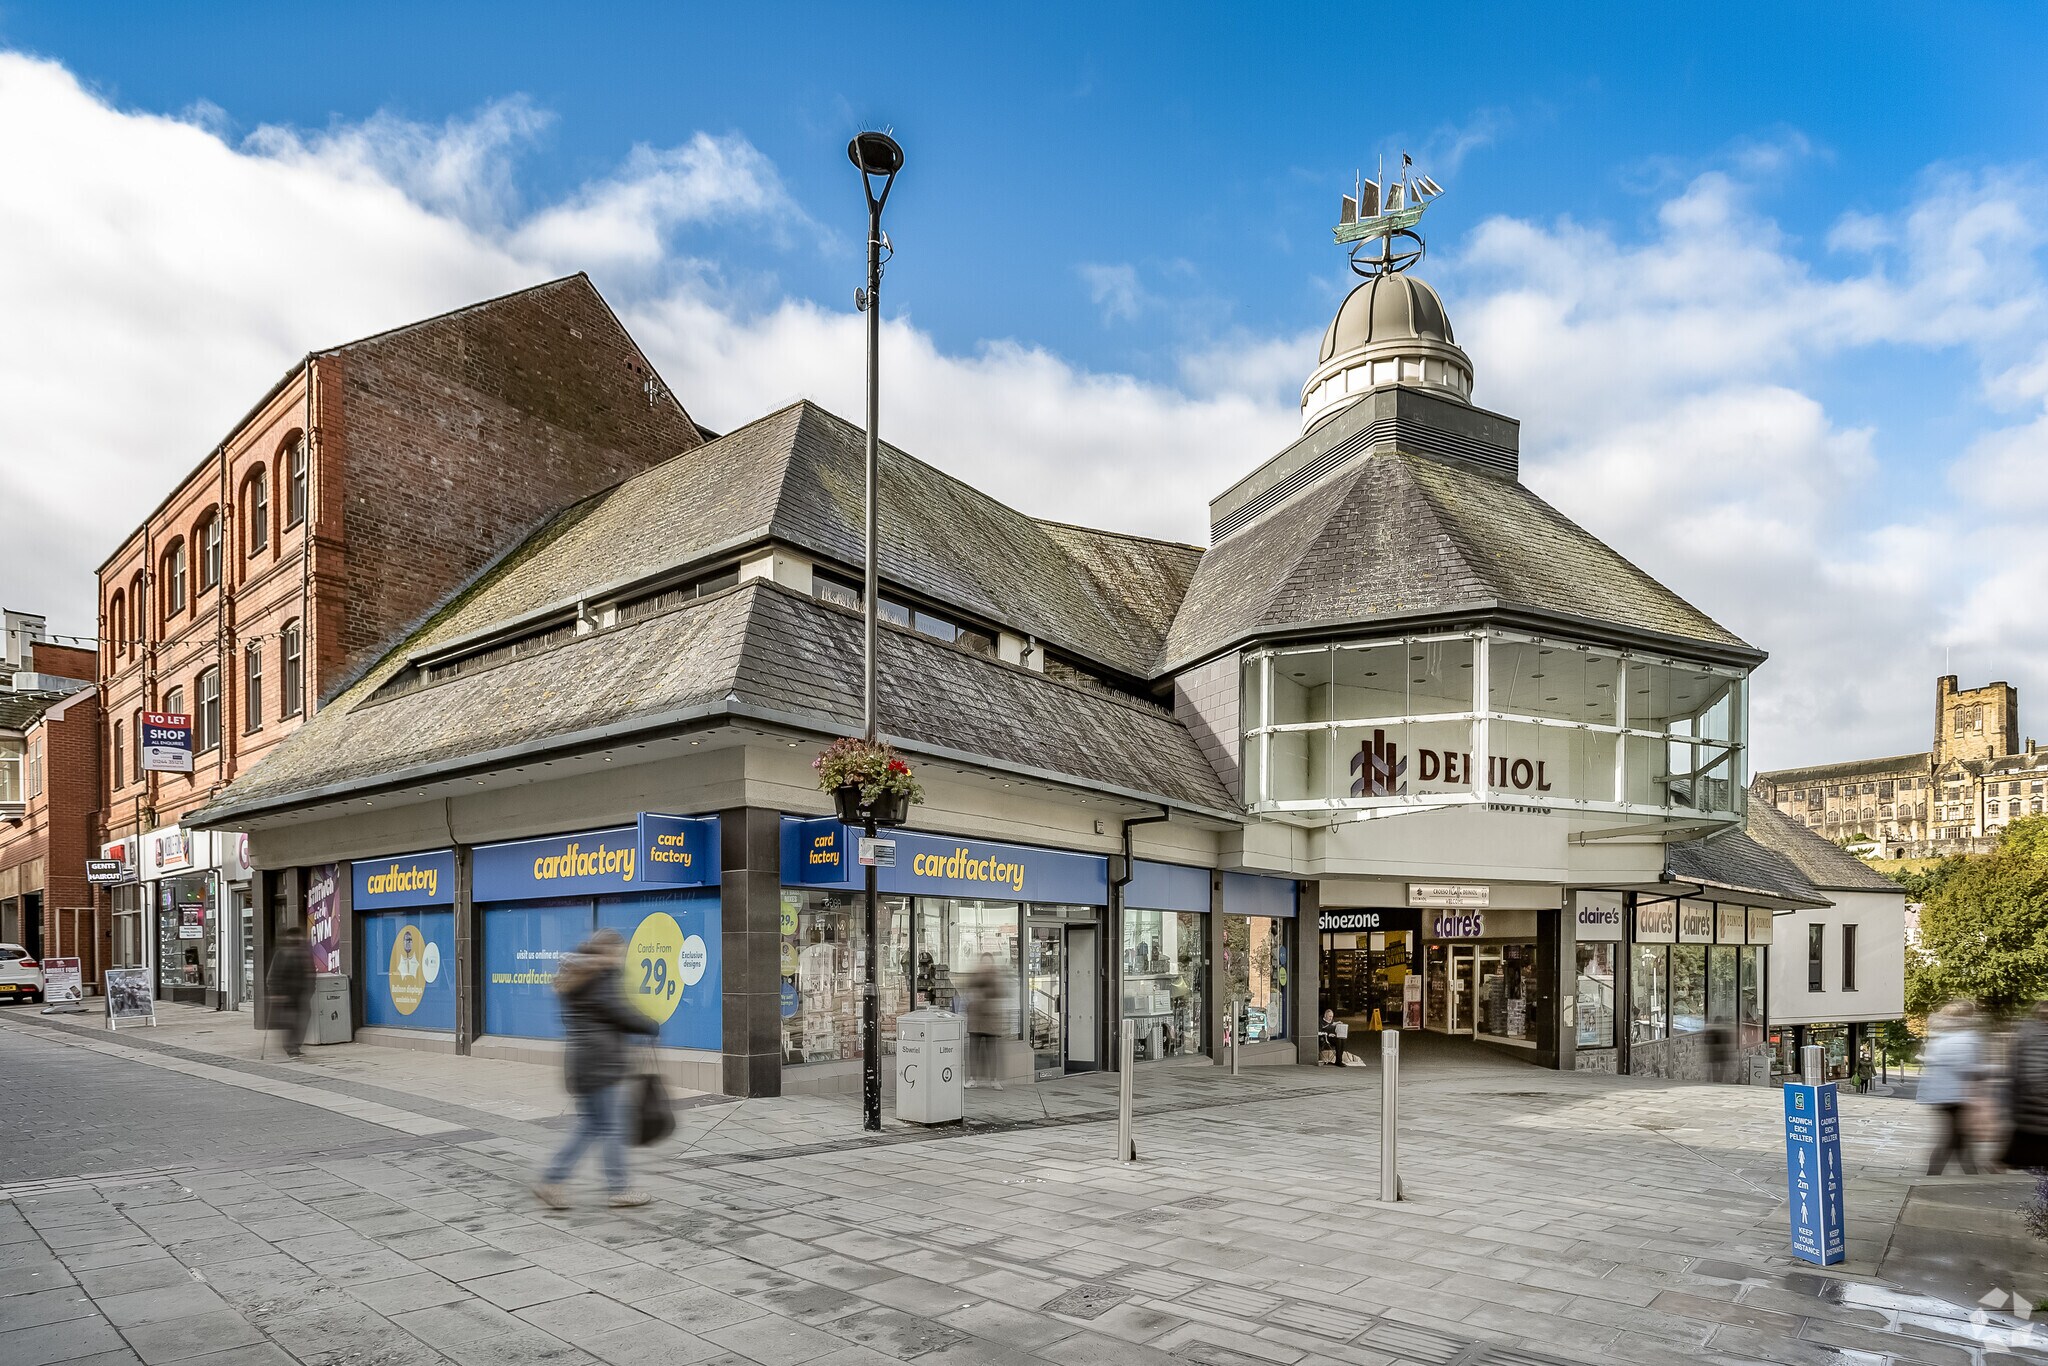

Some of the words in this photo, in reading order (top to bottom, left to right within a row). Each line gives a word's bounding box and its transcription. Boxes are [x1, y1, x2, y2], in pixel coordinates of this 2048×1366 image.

[149, 715, 165, 724] TO
[167, 716, 186, 725] LET
[150, 729, 186, 740] SHOP
[657, 832, 685, 847] card
[814, 831, 835, 848] card
[534, 843, 636, 882] cardfactory
[650, 847, 693, 868] factory
[809, 849, 840, 866] factory
[91, 862, 116, 870] GENTS
[913, 847, 1025, 893] cardfactory
[367, 863, 438, 897] cardfactory
[1318, 911, 1380, 930] shoezone
[1578, 905, 1620, 925] claire's
[1640, 904, 1673, 934] claire's
[1726, 914, 1744, 927] DEINIOL
[1433, 909, 1483, 938] claire's
[1683, 906, 1711, 937] claire's
[310, 916, 332, 947] GWM
[637, 943, 655, 954] Cards
[656, 943, 672, 953] From
[516, 950, 528, 960] visit
[529, 951, 535, 960] us
[535, 950, 552, 960] online
[552, 950, 559, 959] at
[681, 951, 703, 960] Exclusive
[683, 959, 702, 968] designs
[492, 969, 555, 984] www.cardfacto
[1431, 980, 1444, 991] FREE
[901, 1045, 921, 1054] Sbwriel
[939, 1046, 953, 1054] Litter
[1788, 1115, 1813, 1126] CADWCH
[1820, 1117, 1837, 1126] CADWCH
[1794, 1125, 1808, 1134] EICH
[1824, 1126, 1834, 1134] EICH
[1789, 1132, 1814, 1144] PELLTER
[1821, 1133, 1838, 1144] PELLTER
[1797, 1178, 1809, 1190] 2m
[1827, 1181, 1837, 1191] 2m
[1798, 1226, 1814, 1237] KEEP
[1828, 1228, 1840, 1238] KEEP
[1798, 1235, 1815, 1246] YOUR
[1829, 1237, 1841, 1247] YOUR
[1793, 1241, 1820, 1256] DISTANCE
[1825, 1244, 1844, 1257] DISTANCE
